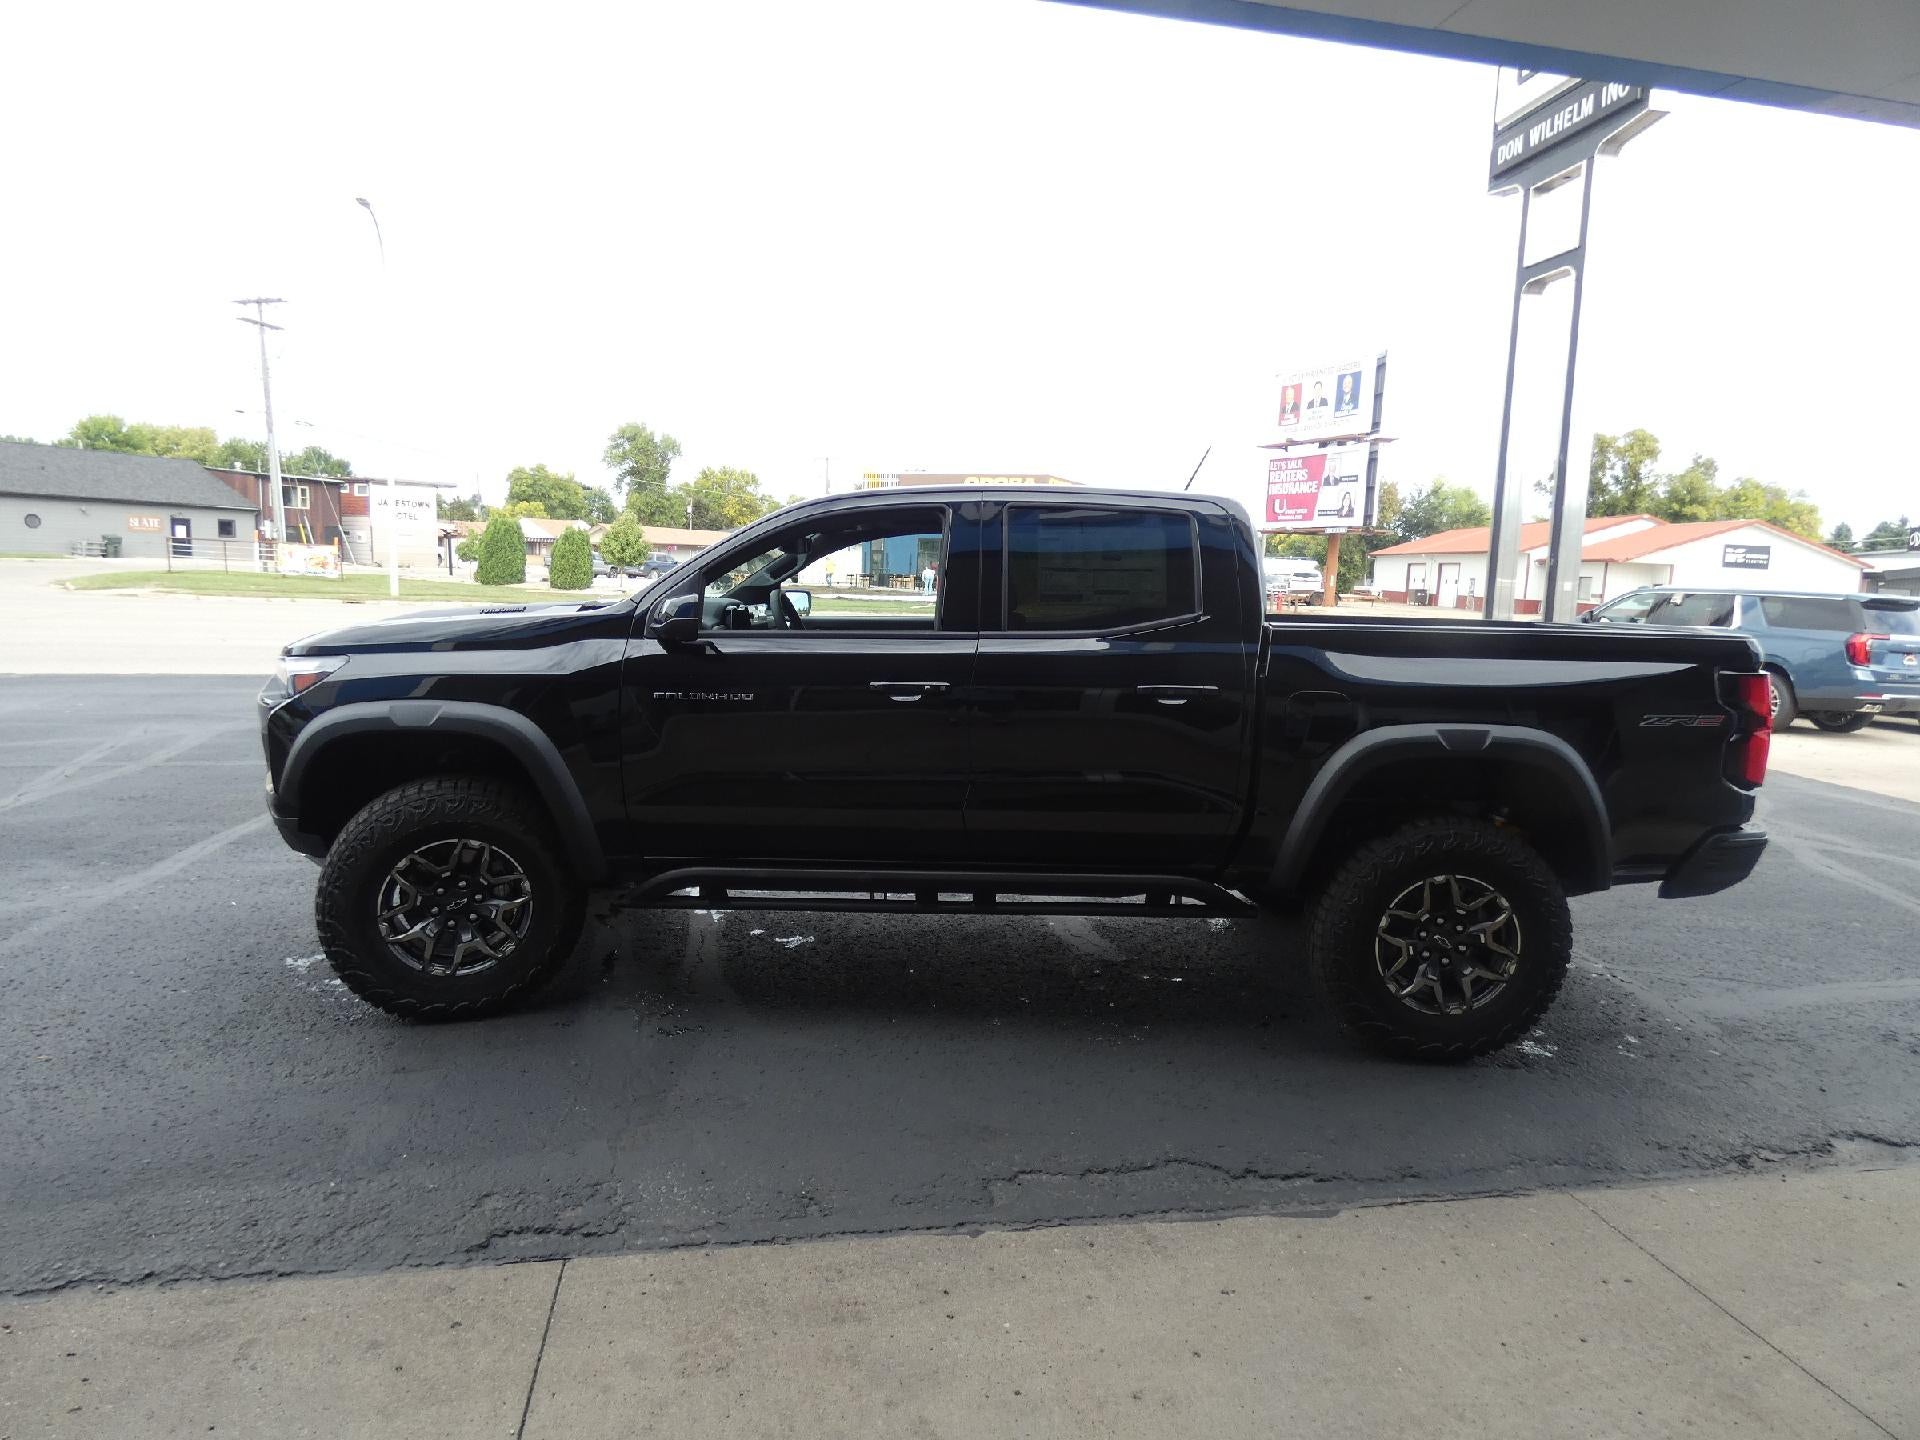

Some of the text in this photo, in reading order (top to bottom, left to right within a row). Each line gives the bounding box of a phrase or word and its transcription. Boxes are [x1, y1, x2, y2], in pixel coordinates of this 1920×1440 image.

[1497, 134, 1524, 165] DON
[1529, 93, 1595, 147] WILHELM
[1269, 469, 1308, 481] RENTERS
[1269, 481, 1318, 495] INSURANCE
[378, 499, 431, 508] JAESTOWN
[1639, 714, 1725, 727] ZR2
